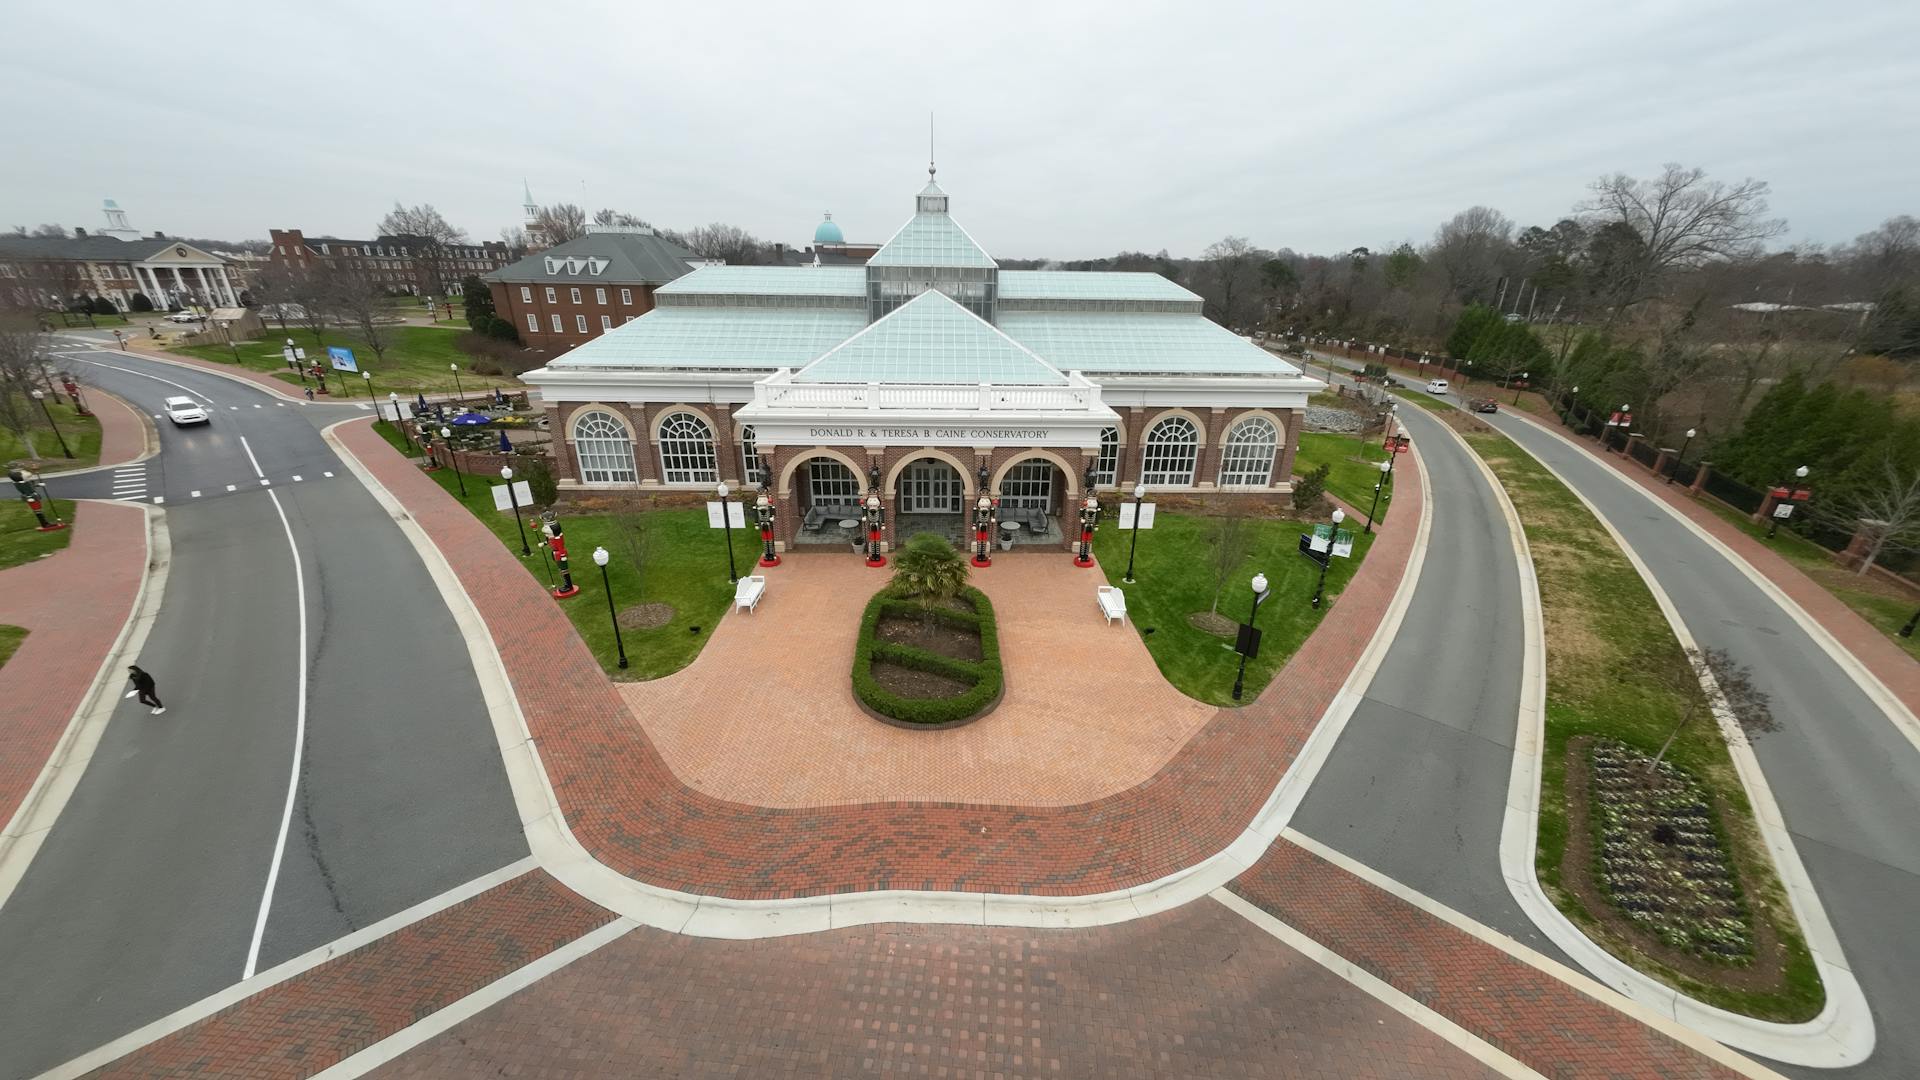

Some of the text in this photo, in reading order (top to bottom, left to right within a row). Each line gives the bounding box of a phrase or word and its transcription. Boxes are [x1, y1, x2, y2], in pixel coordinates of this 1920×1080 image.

[810, 428, 853, 437] DONALD
[870, 429, 877, 437] &
[882, 429, 919, 438] TERESA
[935, 429, 966, 438] CAINE
[970, 430, 1049, 438] CONSERVATORY
